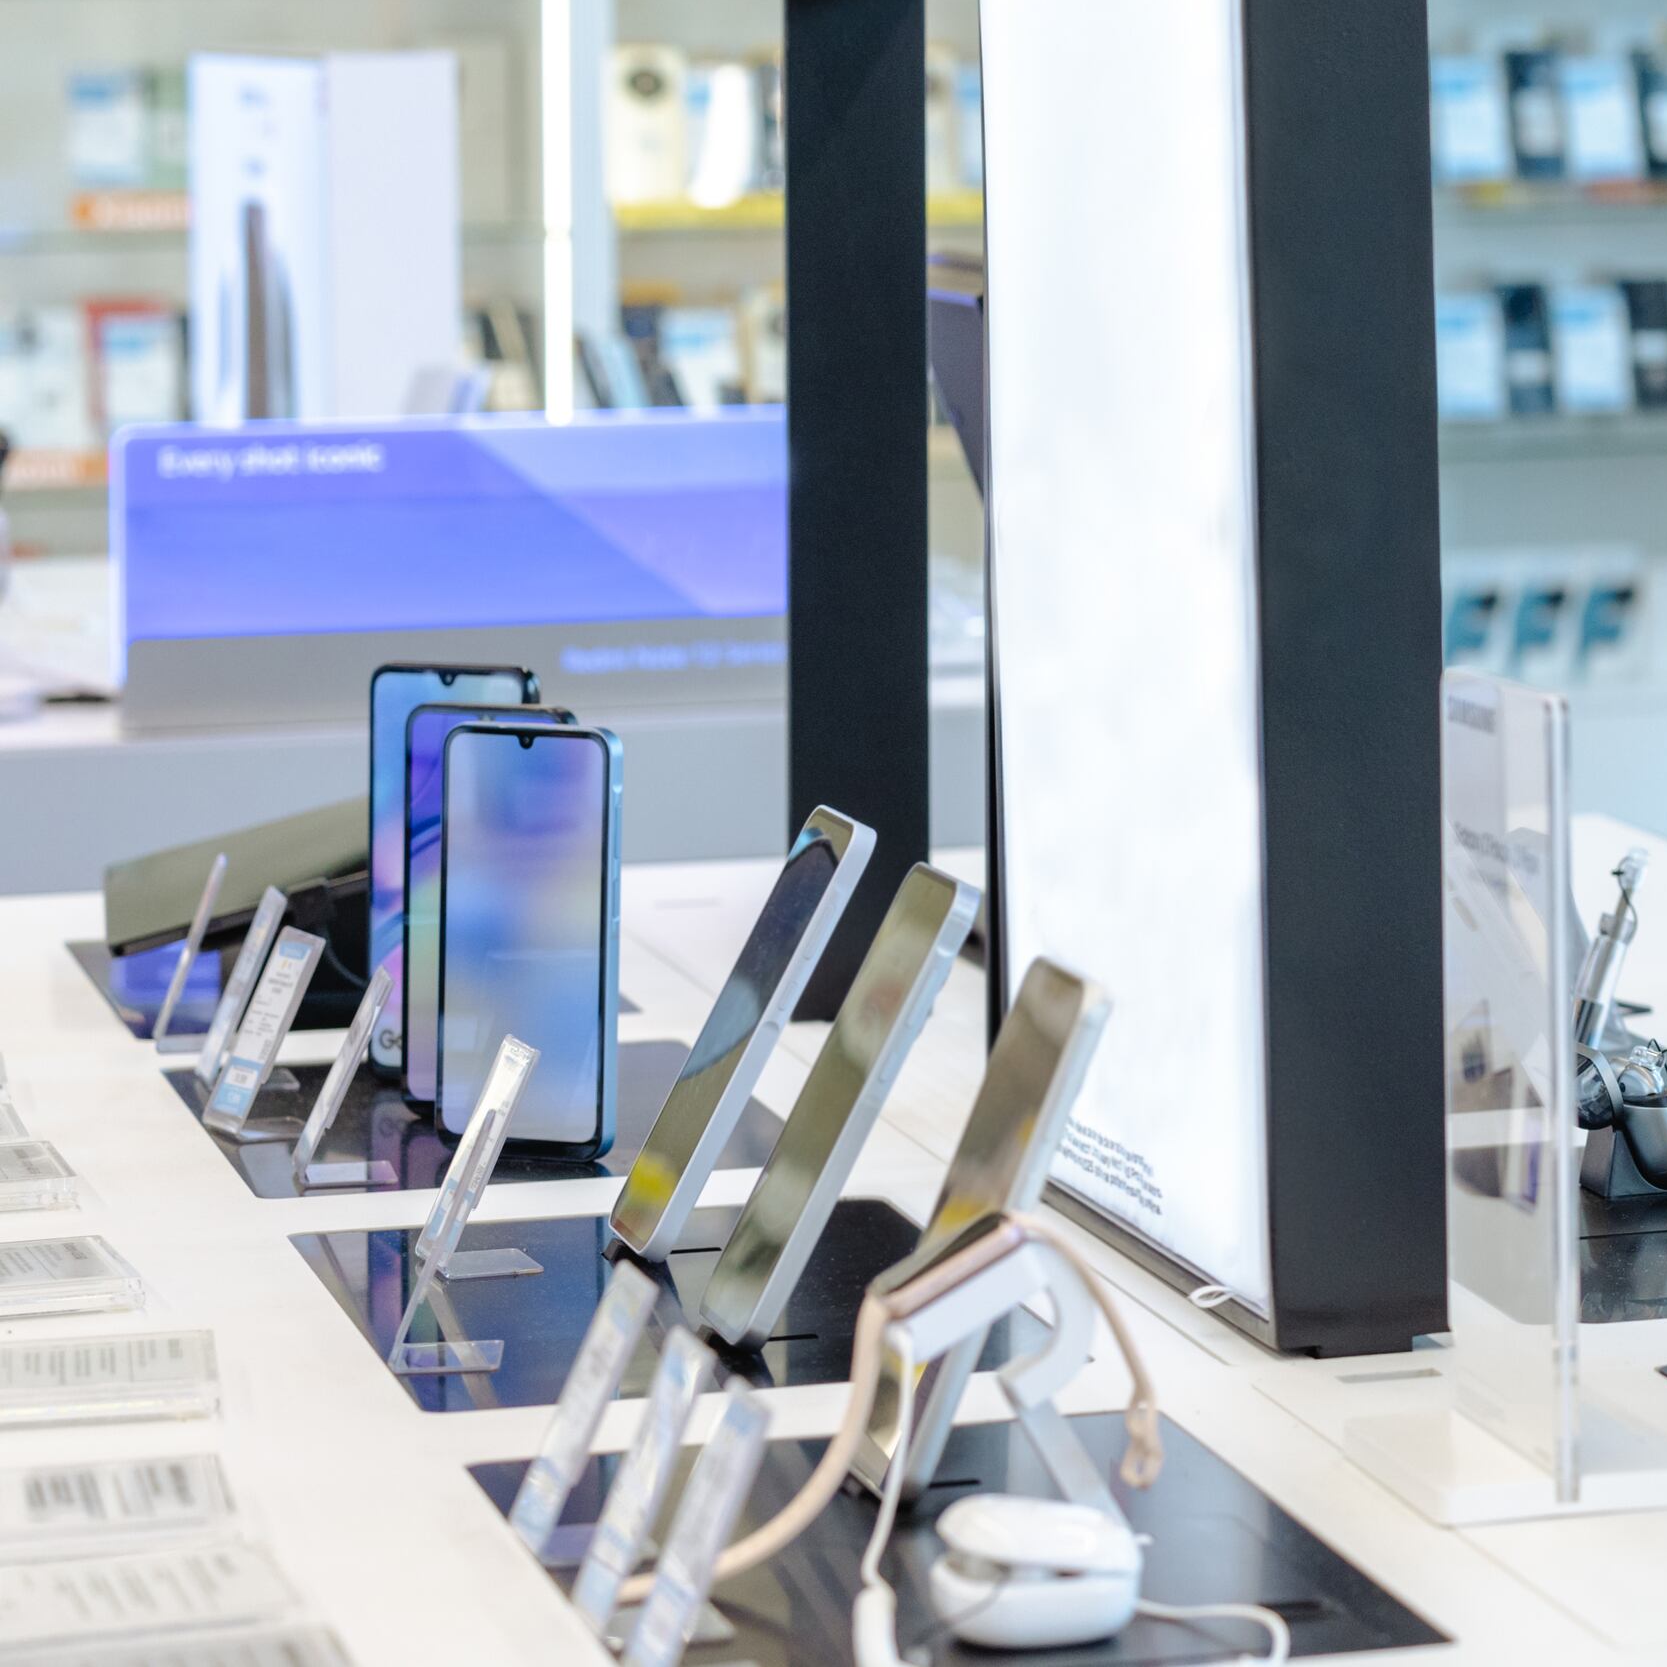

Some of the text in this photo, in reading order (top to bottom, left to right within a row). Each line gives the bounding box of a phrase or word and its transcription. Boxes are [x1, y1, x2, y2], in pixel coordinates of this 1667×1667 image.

[158, 439, 386, 482] Every shot iconic
